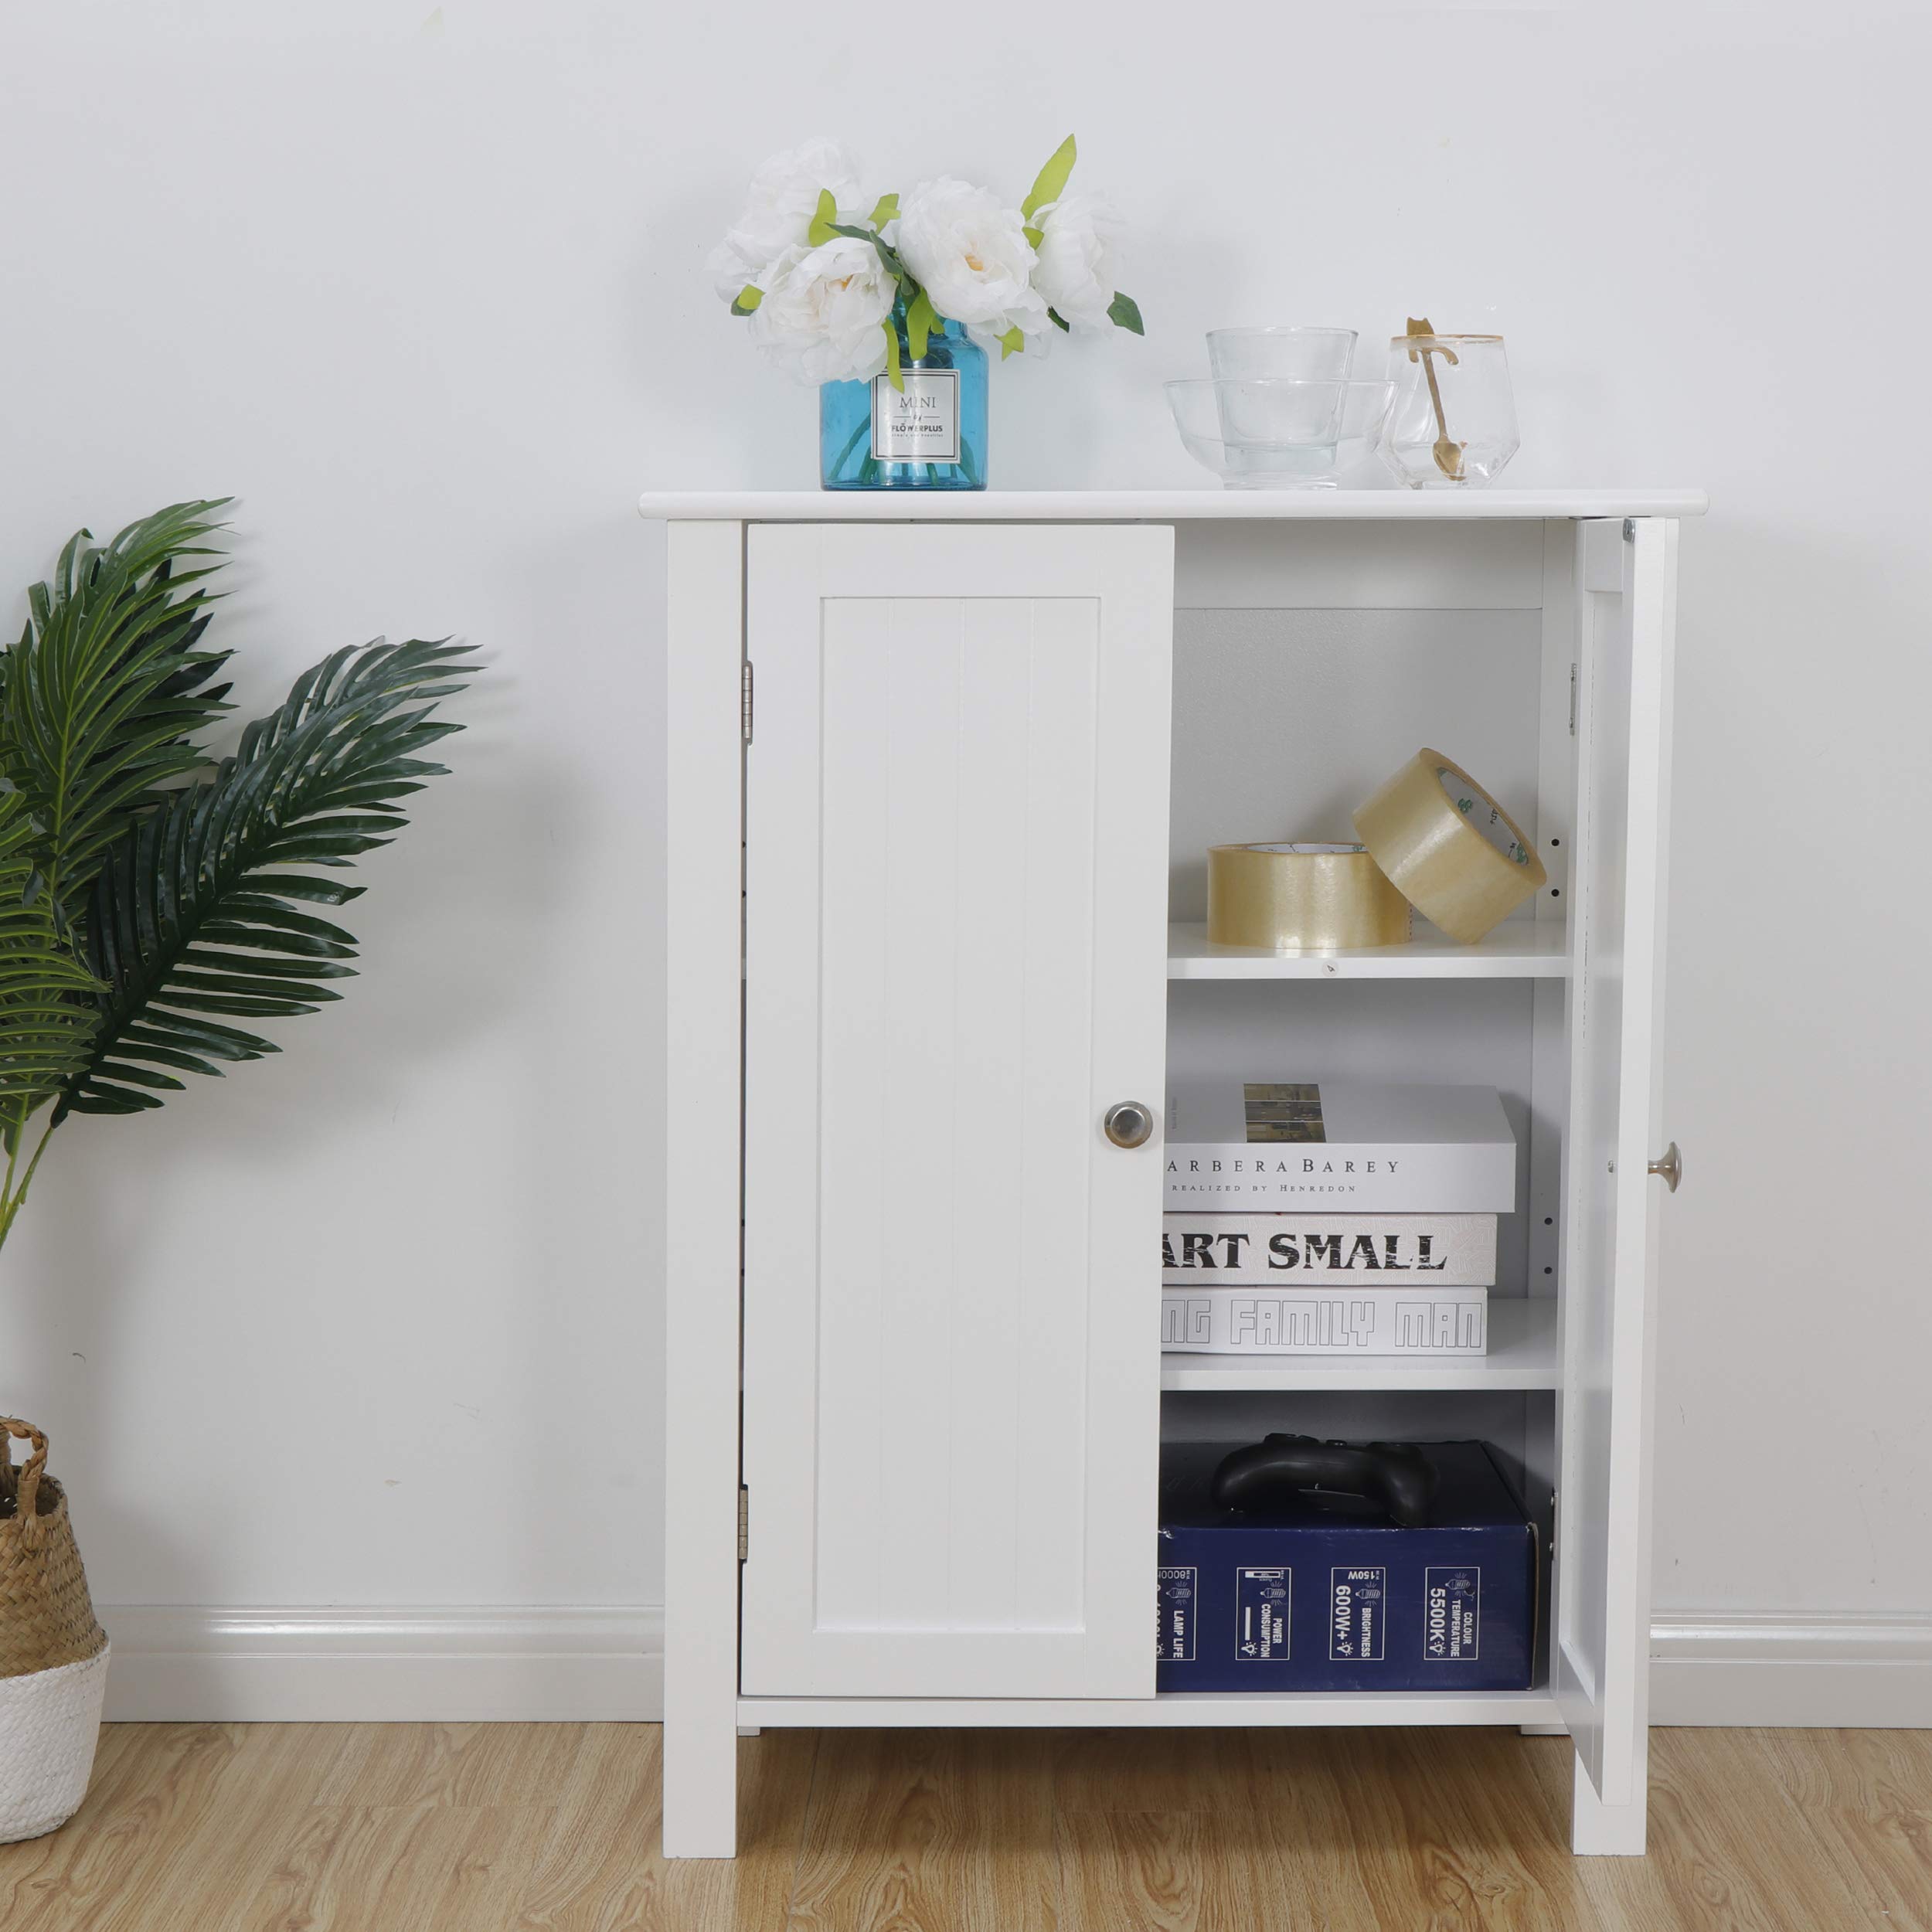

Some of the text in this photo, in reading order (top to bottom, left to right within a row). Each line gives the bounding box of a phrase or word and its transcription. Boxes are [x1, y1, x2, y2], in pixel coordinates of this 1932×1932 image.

[899, 396, 936, 408] MINI
[1303, 1158, 1399, 1173] BAREY
[1268, 1233, 1448, 1270] SMALL
[1230, 1300, 1376, 1346] FAMILY
[1395, 1302, 1482, 1348] MAN
[1348, 1570, 1376, 1580] 150W
[1173, 1610, 1185, 1658] LAMP LIFE
[1260, 1604, 1271, 1658] CONSUMPTION
[1272, 1617, 1283, 1644] POWER
[1335, 1585, 1352, 1640] 600W+
[1361, 1607, 1372, 1658] BRIGHTNESS
[1430, 1587, 1446, 1641] 5500K
[1450, 1599, 1461, 1657] TEMPERATURE
[1463, 1611, 1473, 1645] COLOUR
